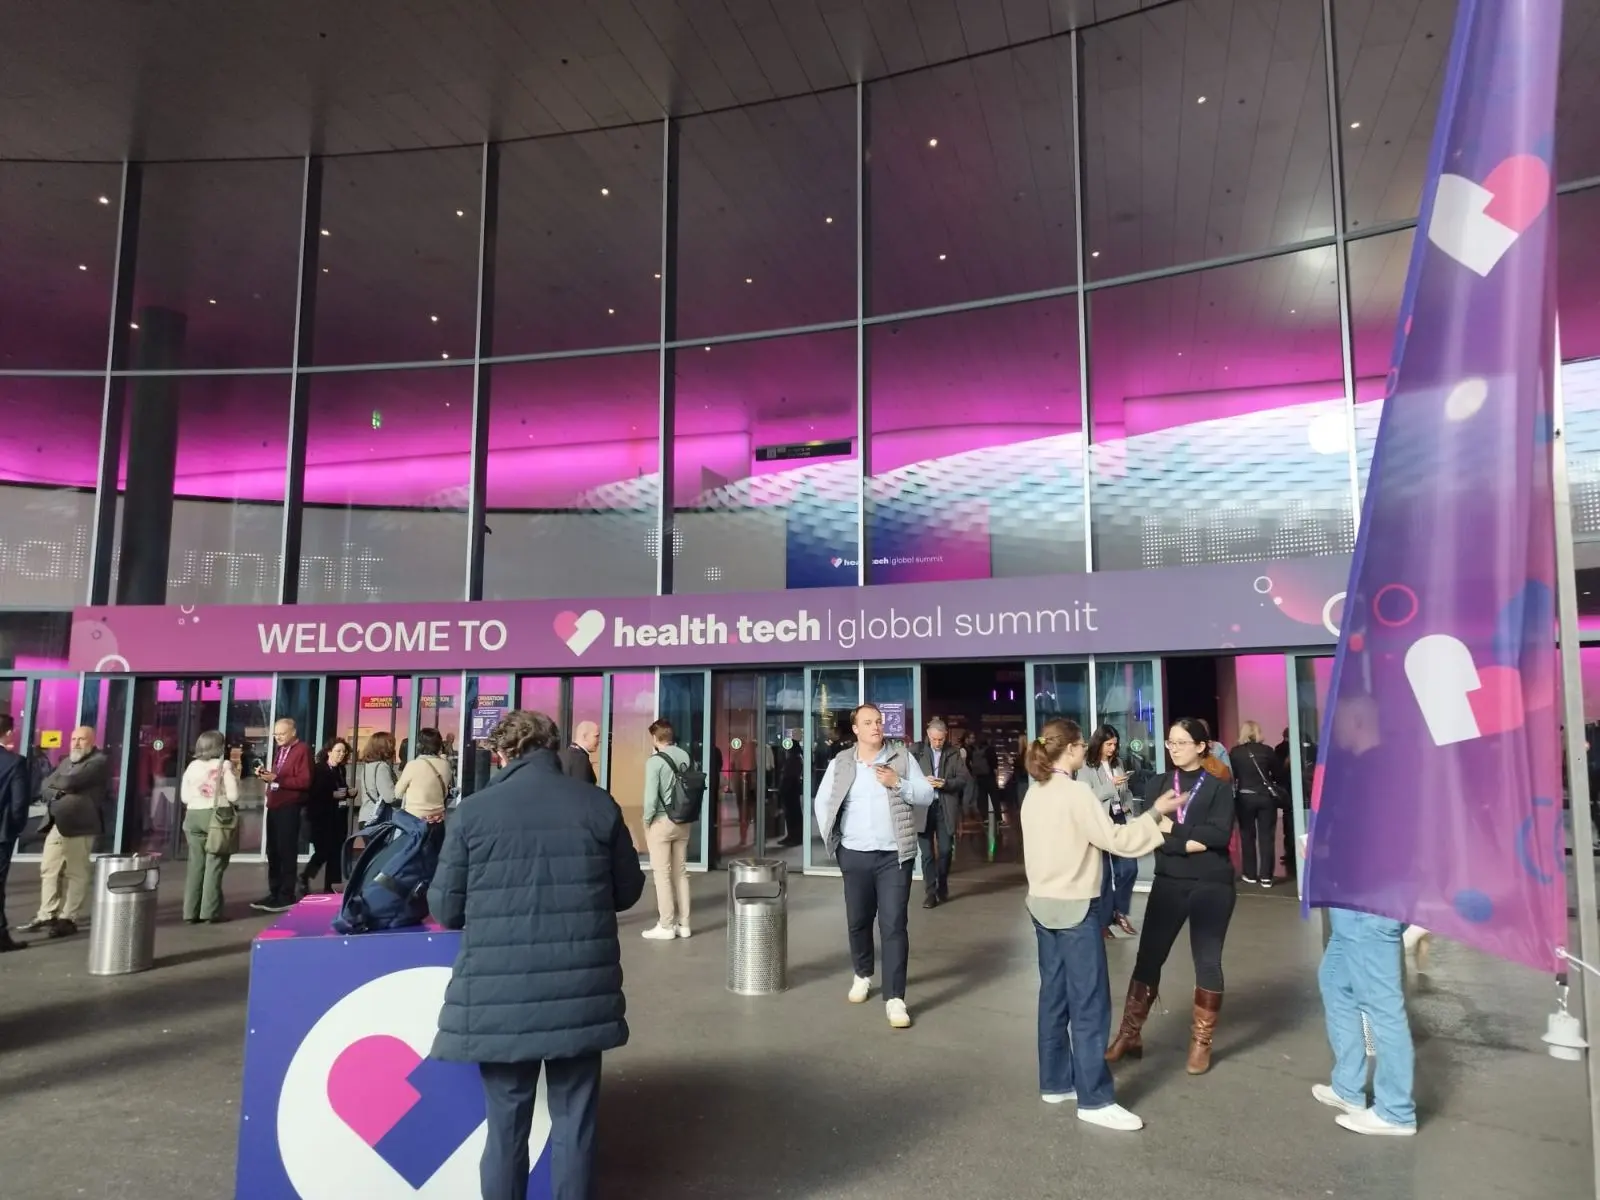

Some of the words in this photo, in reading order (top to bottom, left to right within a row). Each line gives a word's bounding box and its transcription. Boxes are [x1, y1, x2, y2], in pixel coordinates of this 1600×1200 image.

[0, 524, 88, 582] al
[111, 542, 384, 595] ummit
[891, 557, 914, 566] global
[1142, 492, 1355, 569] HEA
[257, 621, 451, 654] WELCOME
[458, 619, 508, 652] TO
[837, 605, 942, 649] global
[954, 600, 1099, 637] summit
